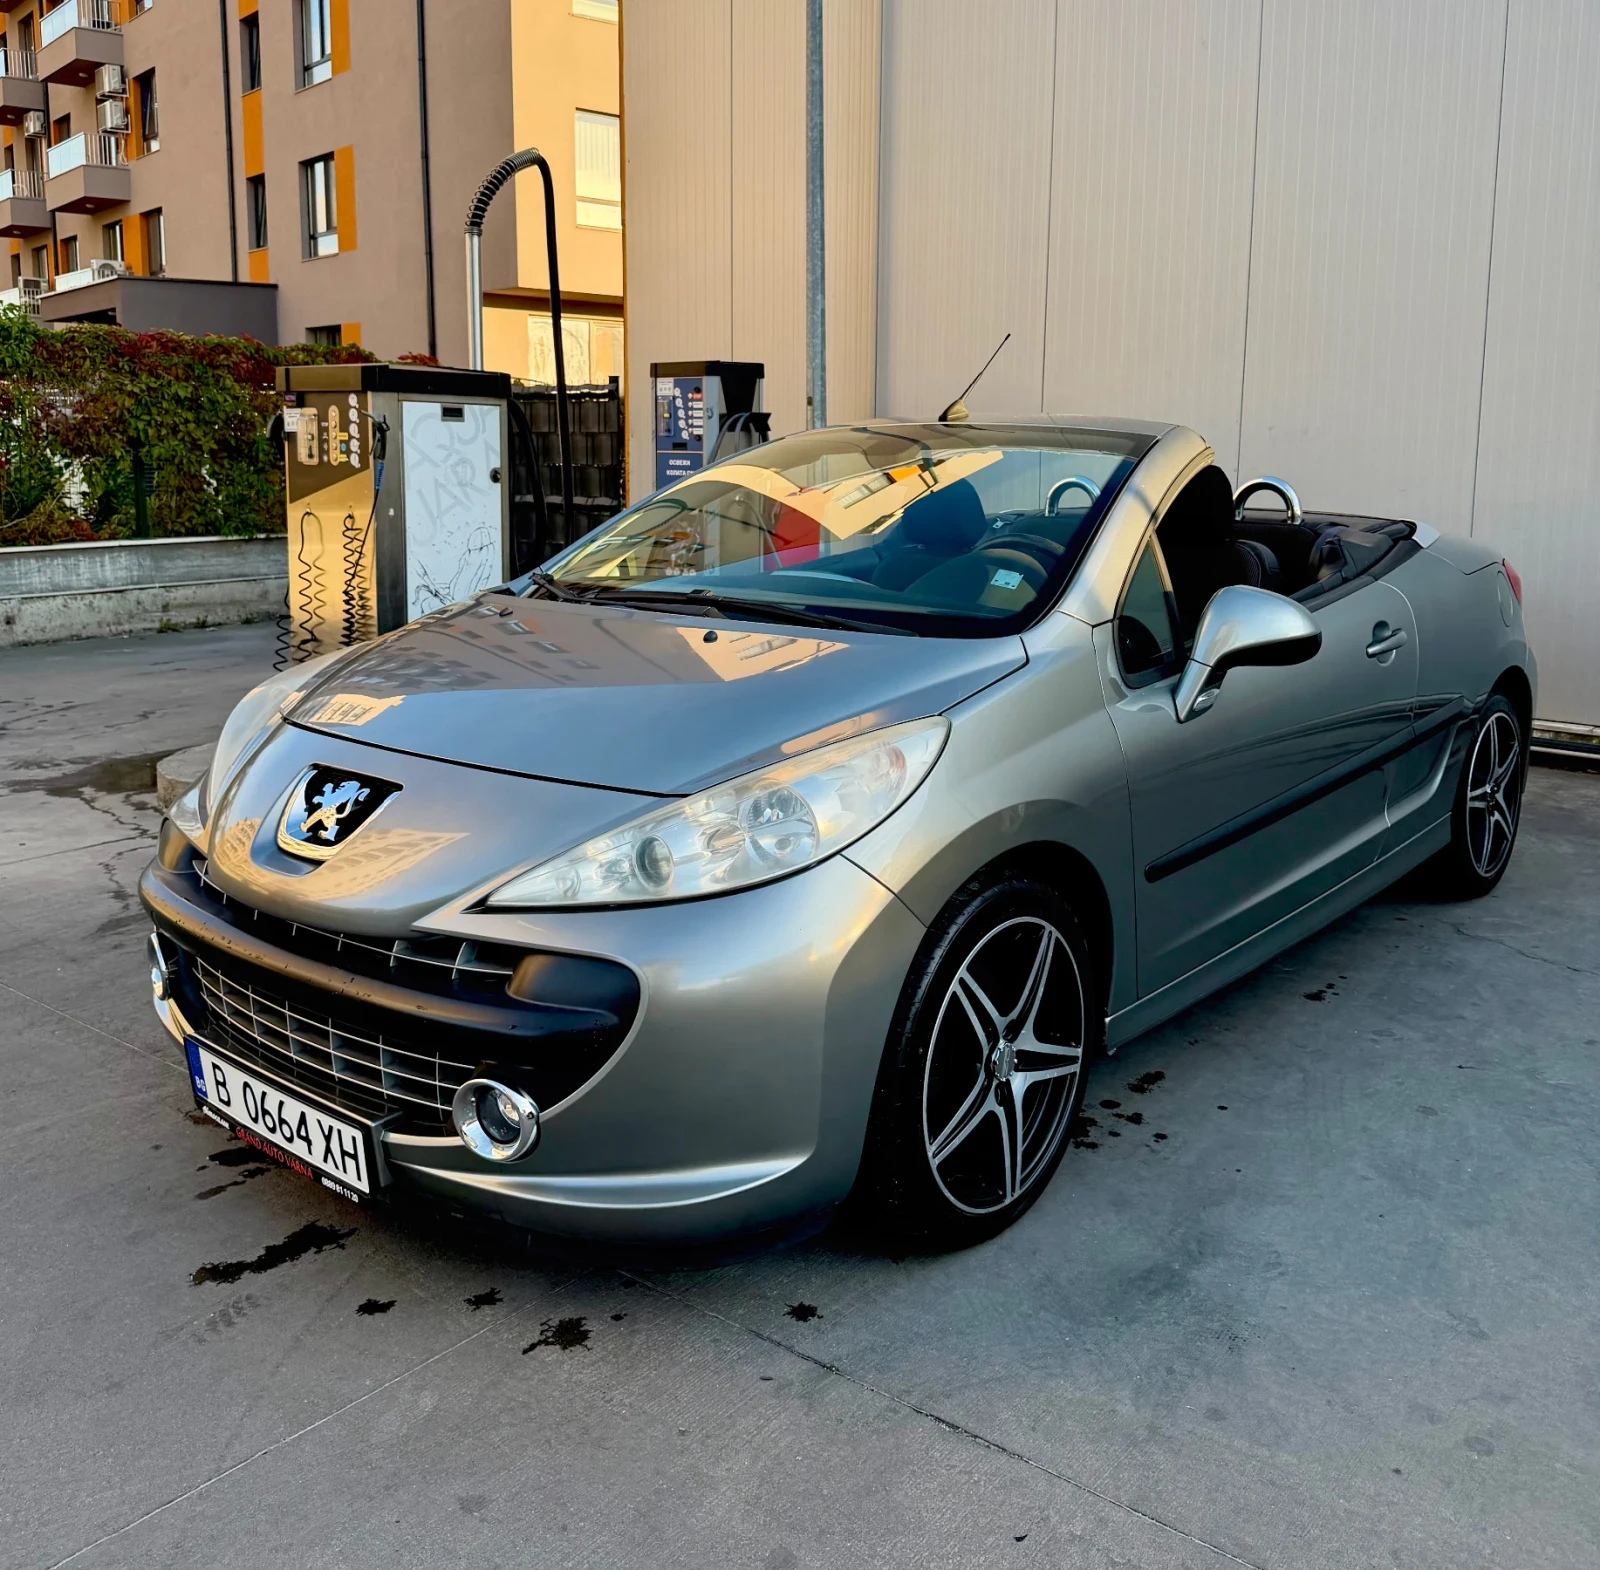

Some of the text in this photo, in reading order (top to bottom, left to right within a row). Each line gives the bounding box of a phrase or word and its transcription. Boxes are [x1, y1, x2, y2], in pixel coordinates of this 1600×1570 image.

[195, 1075, 206, 1092] BG
[211, 1060, 362, 1183] B 0664 XH
[235, 1126, 314, 1180] GRAND AUTO VARNA
